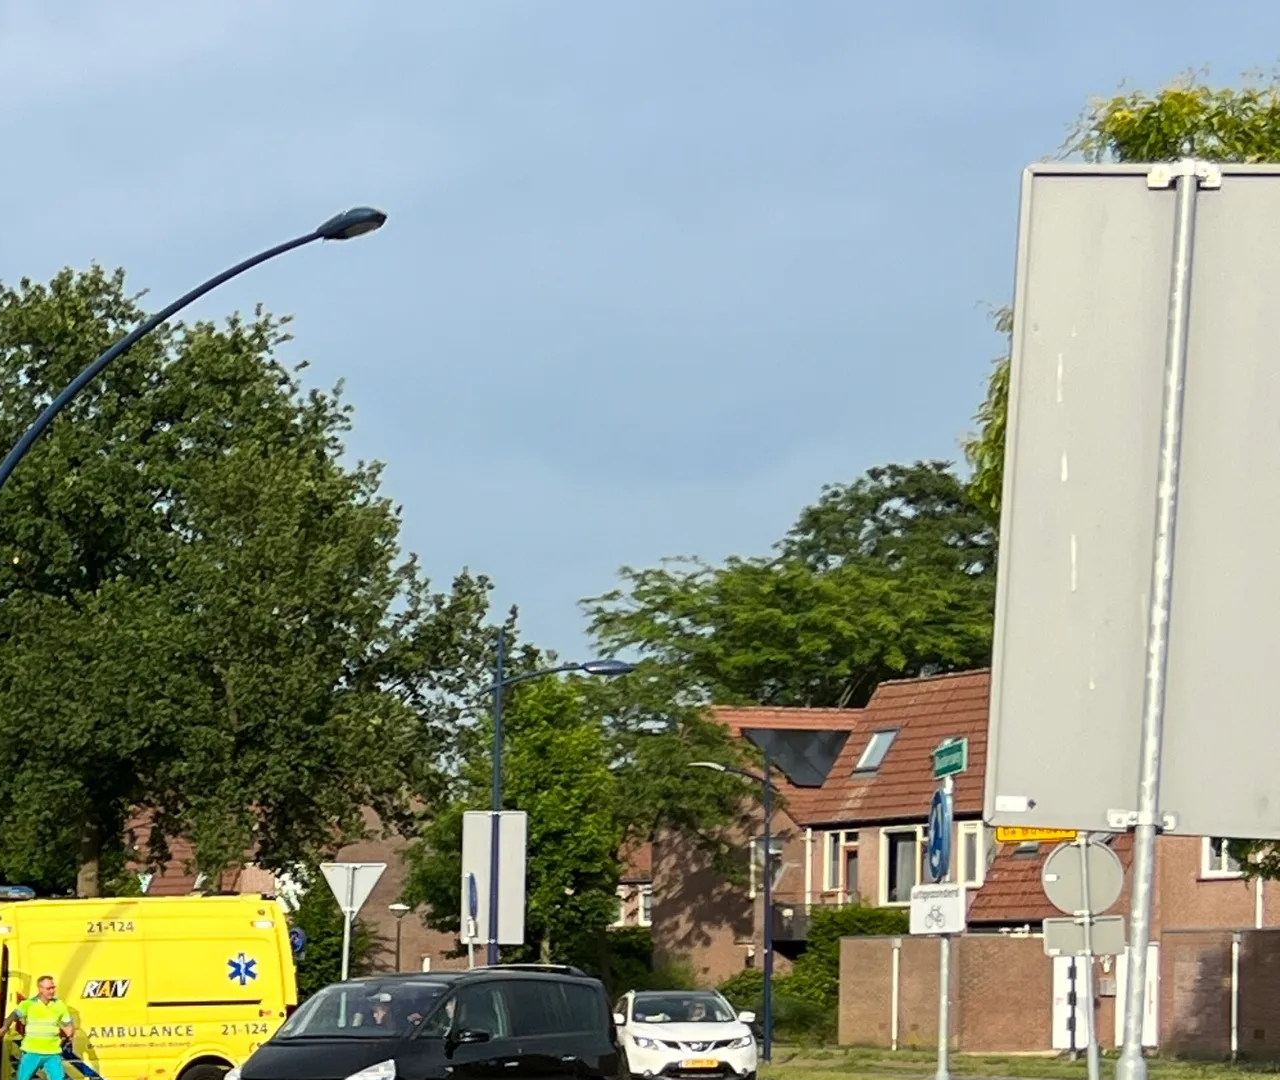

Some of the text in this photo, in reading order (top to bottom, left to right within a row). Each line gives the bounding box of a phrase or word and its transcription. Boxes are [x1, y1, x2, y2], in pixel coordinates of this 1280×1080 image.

[86, 921, 135, 933] 21-124
[81, 979, 131, 999] RAV
[87, 1025, 194, 1038] AMBULANCE
[221, 1023, 268, 1035] 21-124
